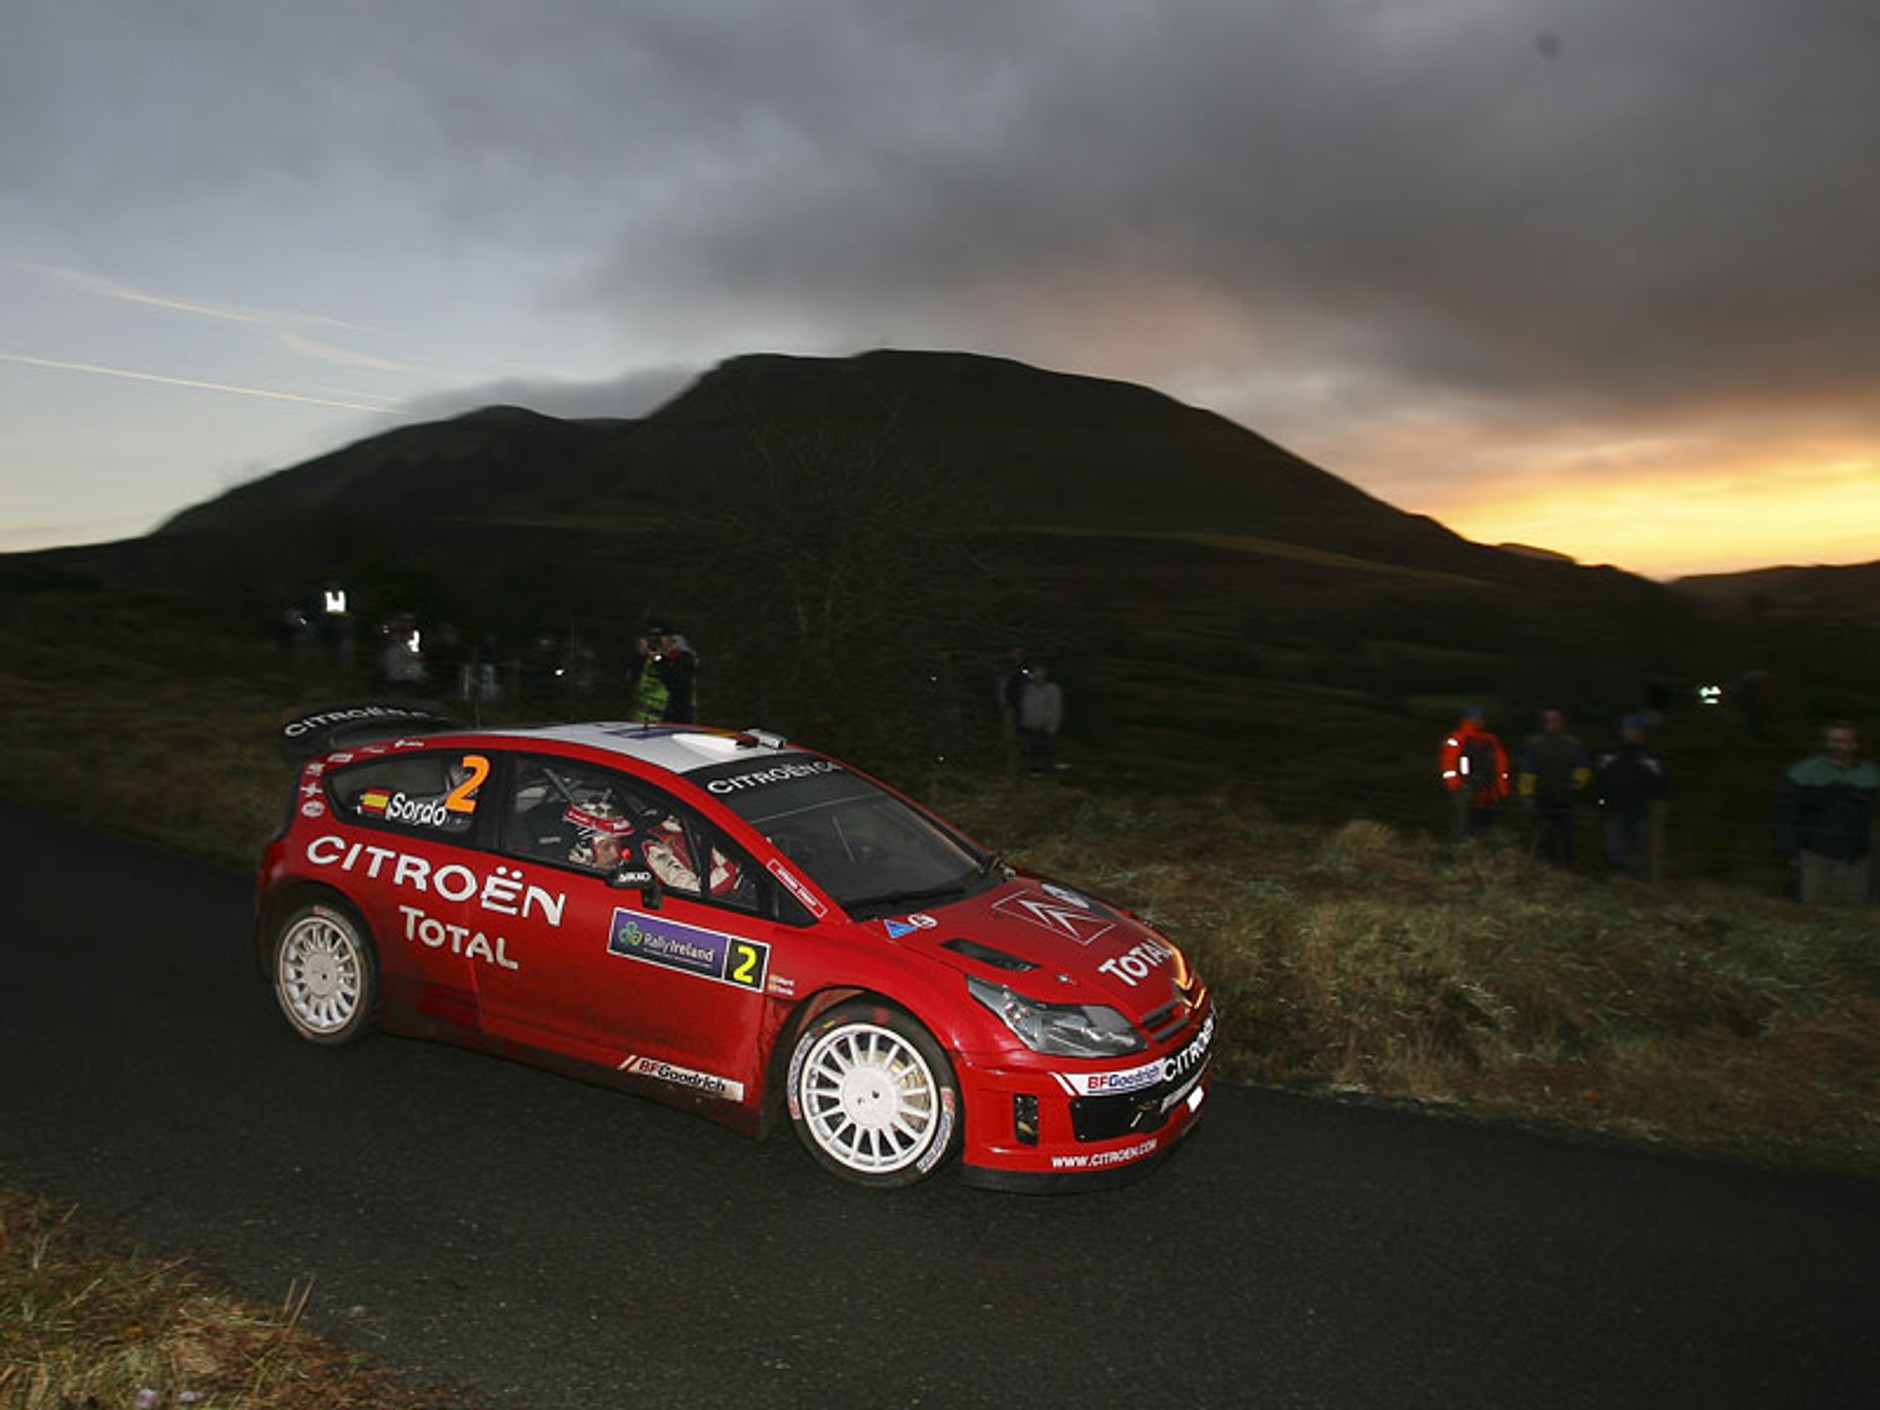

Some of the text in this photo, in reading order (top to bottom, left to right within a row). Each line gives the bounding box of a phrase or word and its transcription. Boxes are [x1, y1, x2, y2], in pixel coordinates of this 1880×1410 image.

[444, 754, 490, 814] 2
[390, 792, 447, 826] Sordo
[306, 835, 566, 927] CITROËN
[733, 945, 757, 984] 2
[639, 1060, 726, 1093] BFGoodrich
